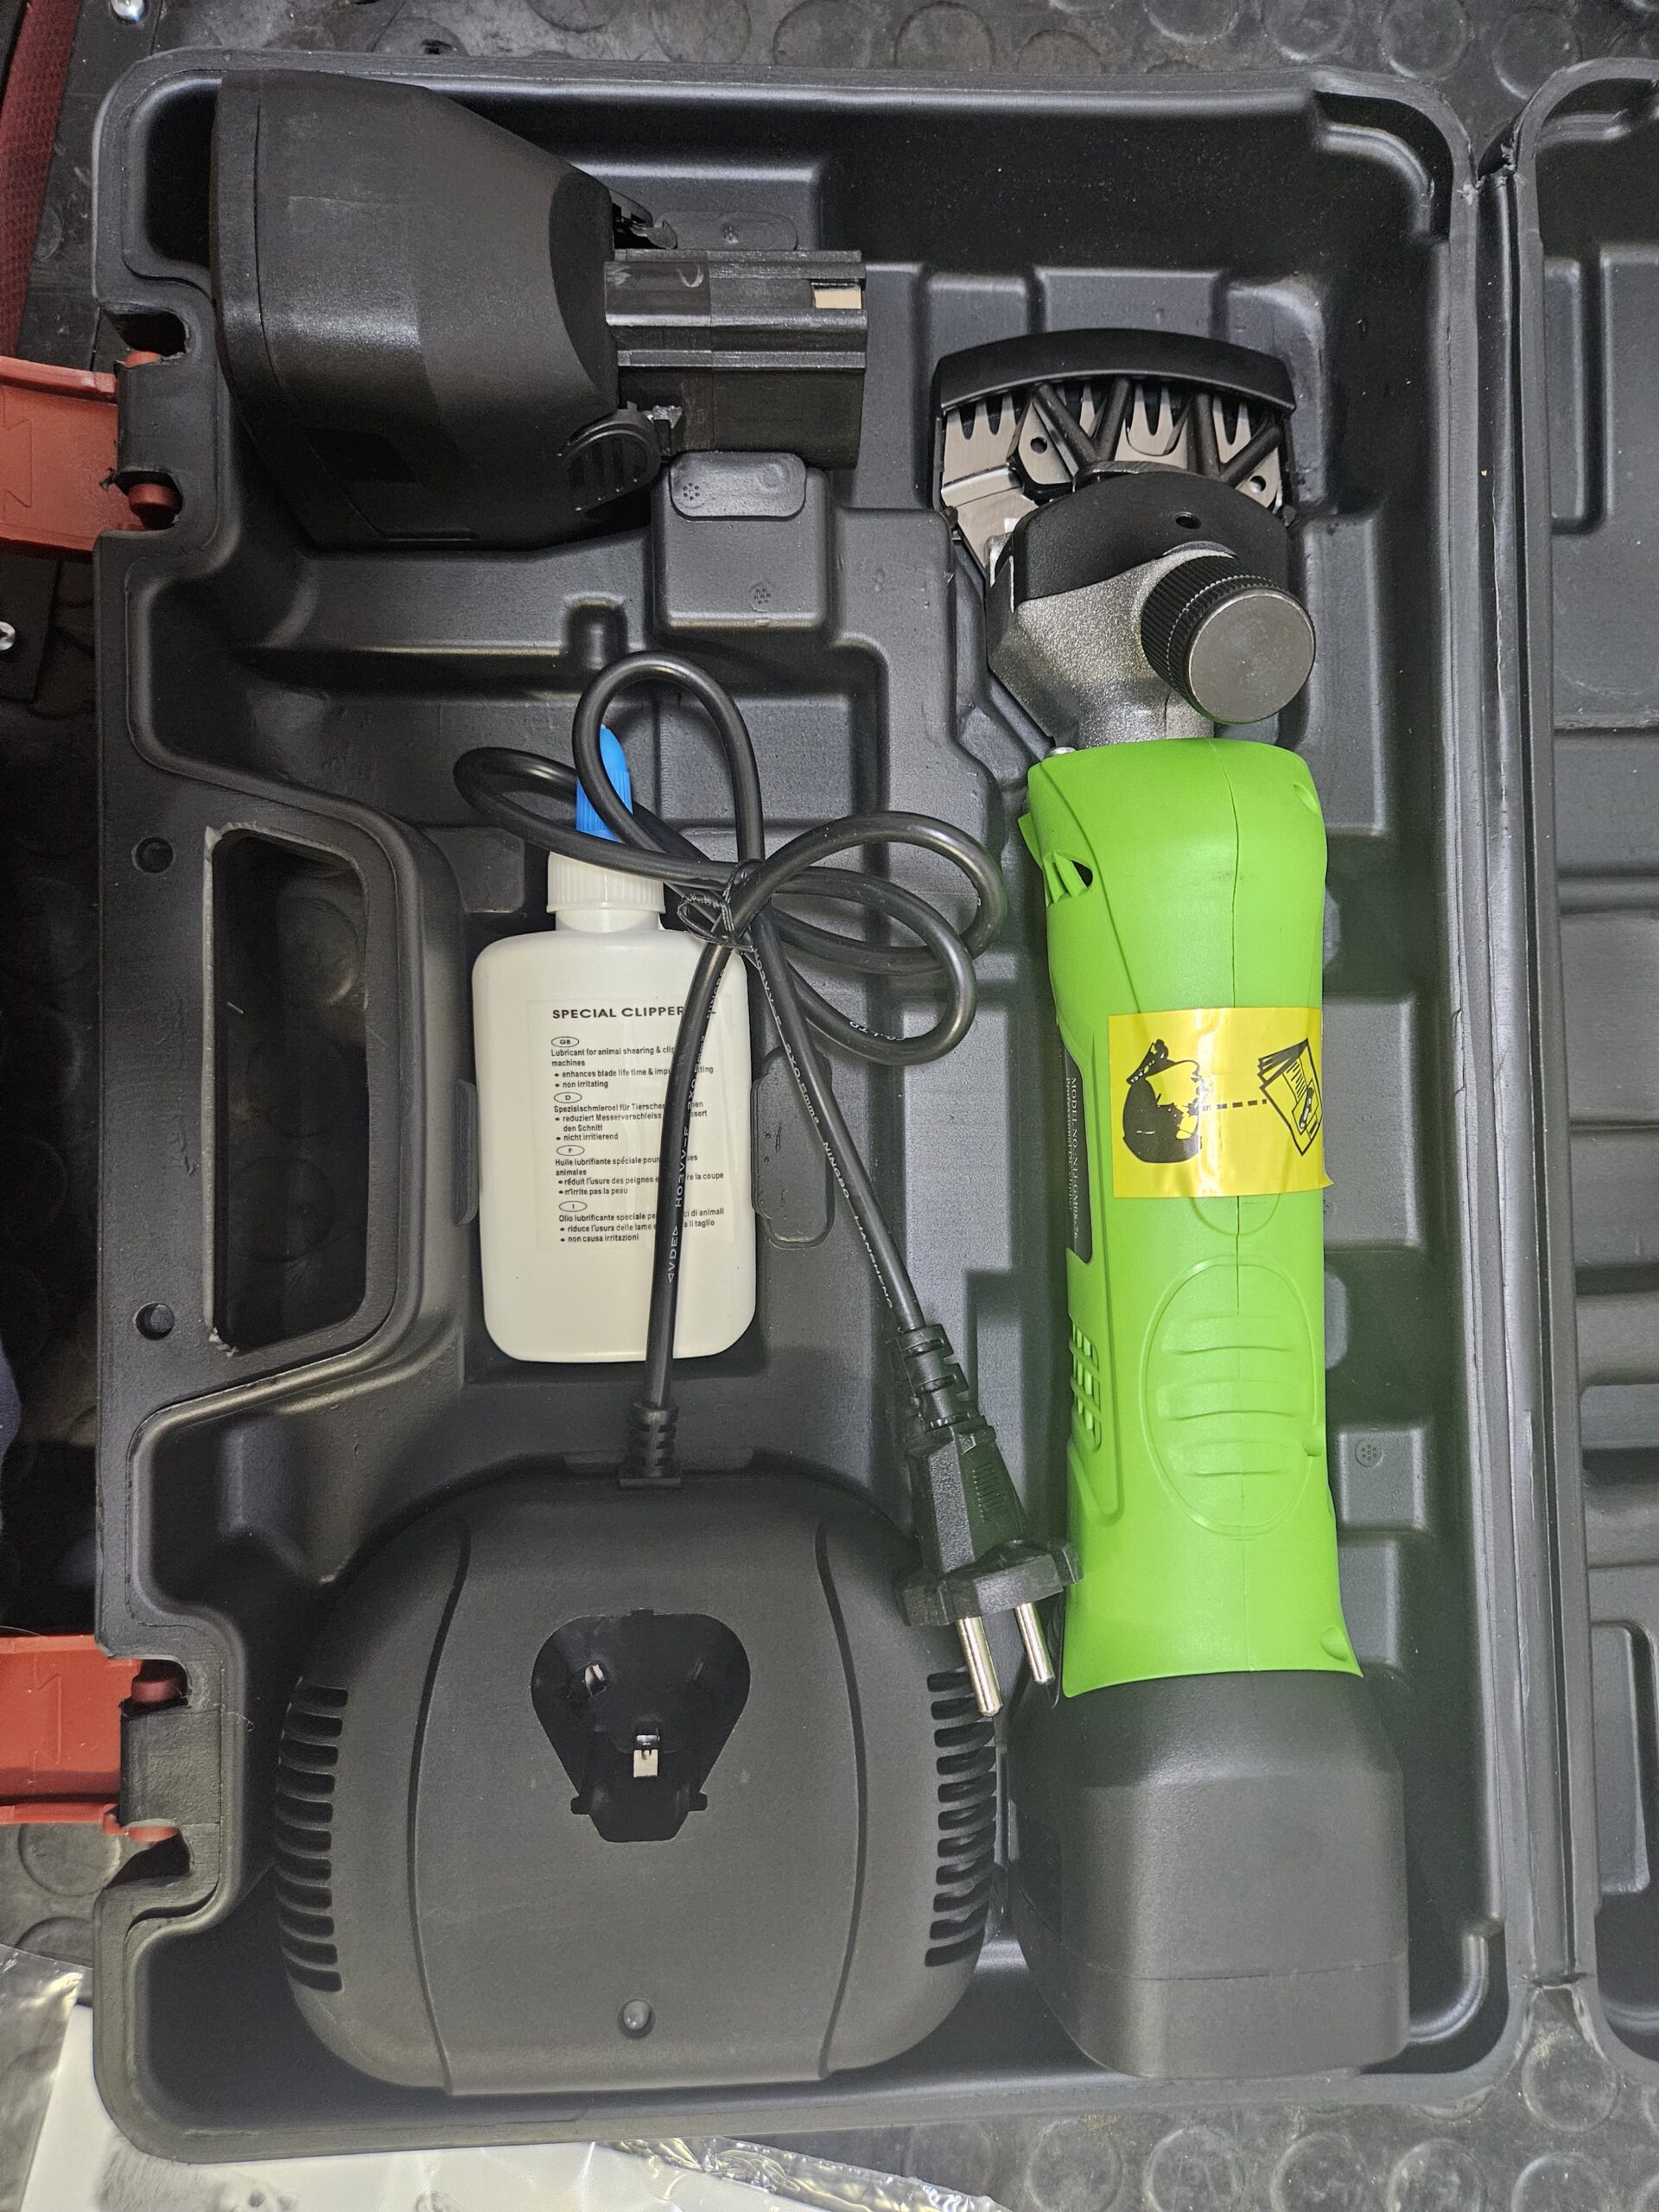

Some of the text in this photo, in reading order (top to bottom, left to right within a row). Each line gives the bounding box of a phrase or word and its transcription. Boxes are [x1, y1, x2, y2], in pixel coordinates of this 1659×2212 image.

[553, 1006, 683, 1020] SPECIAL CLIPPER
[551, 1048, 585, 1057] Lubricant
[598, 1046, 621, 1055] animal
[623, 1046, 654, 1055] shearing
[597, 1069, 617, 1077] blade
[619, 1068, 630, 1077] life
[577, 1080, 608, 1089] irritating
[620, 1103, 630, 1111] für
[563, 1114, 594, 1122] reduziert
[595, 1111, 662, 1122] Messerverschleiss
[582, 1132, 619, 1141] irritierend
[574, 1157, 612, 1166] lubrifiante
[612, 1155, 642, 1166] spéciale
[823, 1141, 849, 1198] NINGBO
[564, 1177, 585, 1185] réduit
[611, 1176, 622, 1185] des
[625, 1176, 654, 1185] peignes
[695, 1172, 702, 1180] la
[702, 1173, 724, 1181] coupe
[611, 1187, 628, 1196] peau
[558, 1214, 574, 1223] Olio
[574, 1213, 615, 1222] lubrificante
[616, 1212, 646, 1223] speciale
[691, 1209, 697, 1217] di
[699, 1207, 724, 1217] animali
[567, 1224, 590, 1233] riduce
[634, 1223, 652, 1231] lame
[695, 1218, 715, 1229] taglio
[604, 1233, 639, 1242] irritazioni
